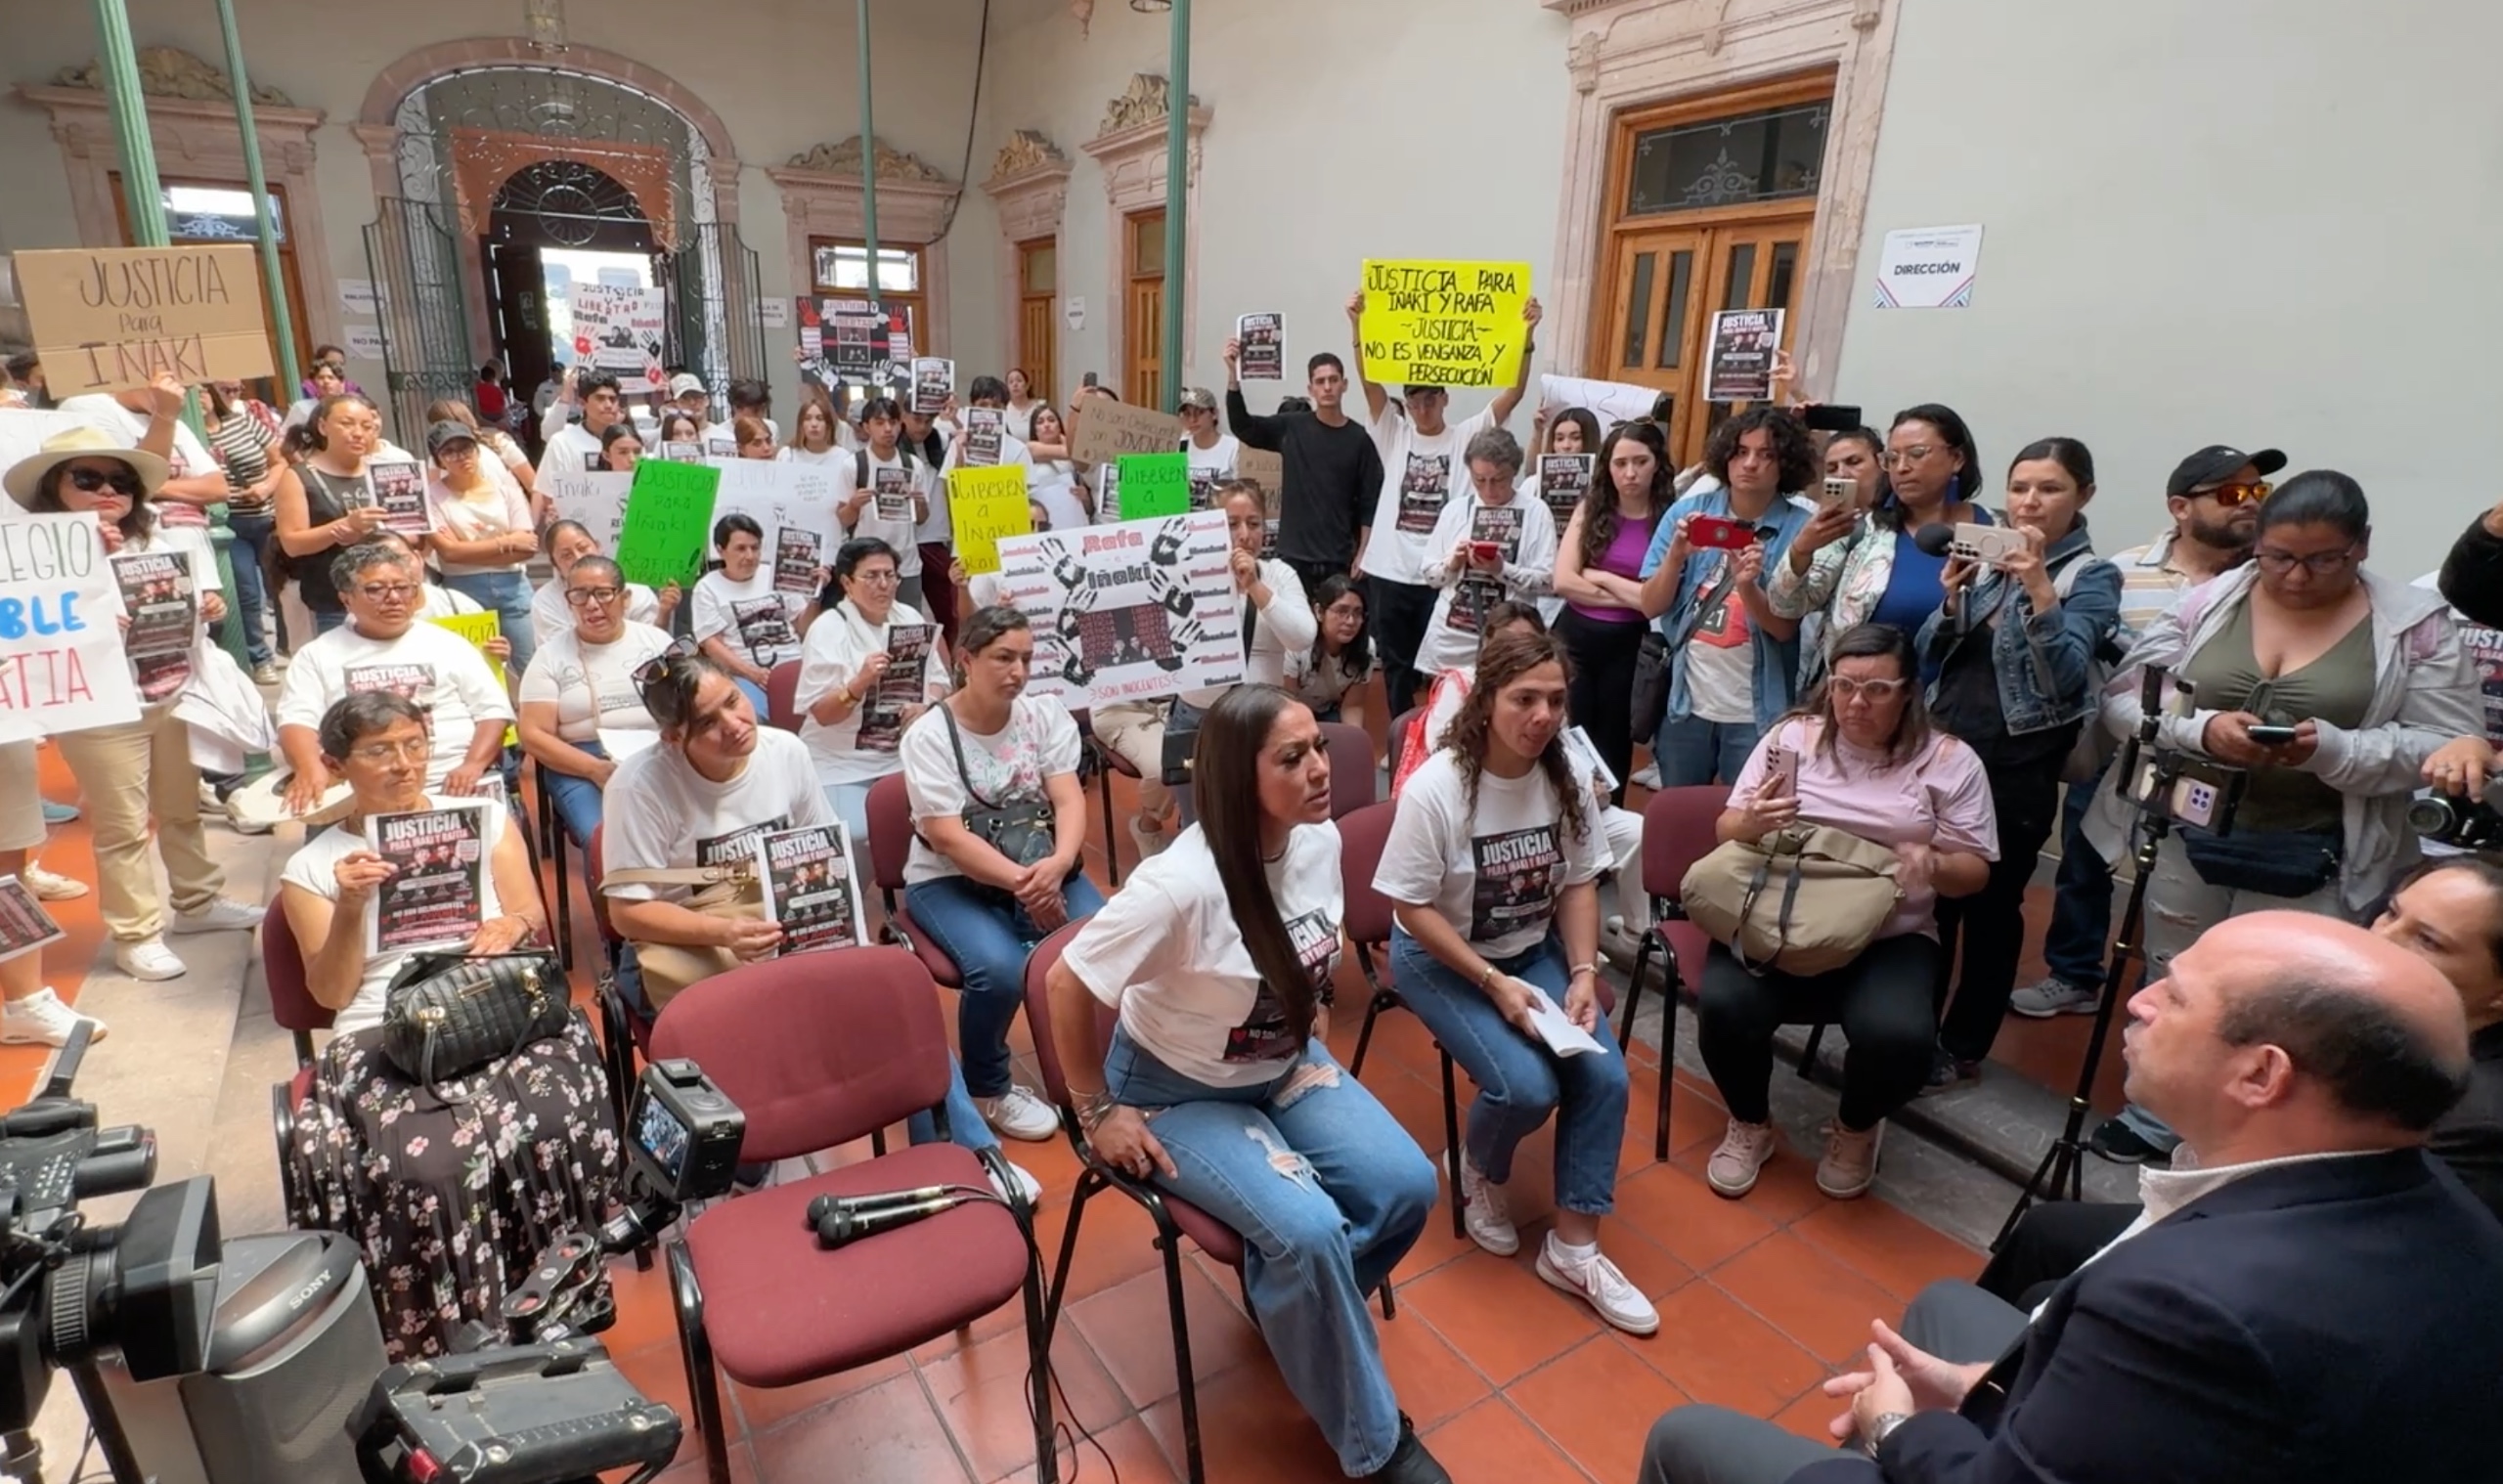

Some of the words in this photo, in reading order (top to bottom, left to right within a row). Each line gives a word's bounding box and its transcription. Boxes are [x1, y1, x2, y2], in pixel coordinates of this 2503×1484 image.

[1369, 265, 1457, 292] JUSTICIA
[1477, 270, 1515, 293] PARA
[1894, 260, 1960, 276] DIRECCIÓN
[80, 255, 229, 309] JUSTICIA
[1439, 293, 1451, 314] Y
[1454, 293, 1495, 314] RAFA
[119, 314, 163, 334] para
[1722, 314, 1765, 328] JUSTICIA
[1364, 341, 1385, 360] NO
[1393, 342, 1411, 361] ES
[1417, 343, 1481, 361] VENGANZA
[1491, 344, 1506, 364] Y
[1409, 362, 1492, 386] PERSECUCIÓN
[0, 520, 92, 583] EGIO
[1083, 529, 1143, 553] Rafa
[116, 555, 174, 578] JUSTICIA
[1087, 562, 1152, 589] Iñaki
[0, 590, 86, 639] BLE
[350, 666, 421, 684] JUSTICIA
[385, 812, 461, 842] JUSTICIA
[769, 831, 830, 860] JUSTICIA
[1482, 831, 1553, 866] JUSTICIA
[1486, 862, 1508, 876] PARA
[289, 1269, 331, 1310] SONY
